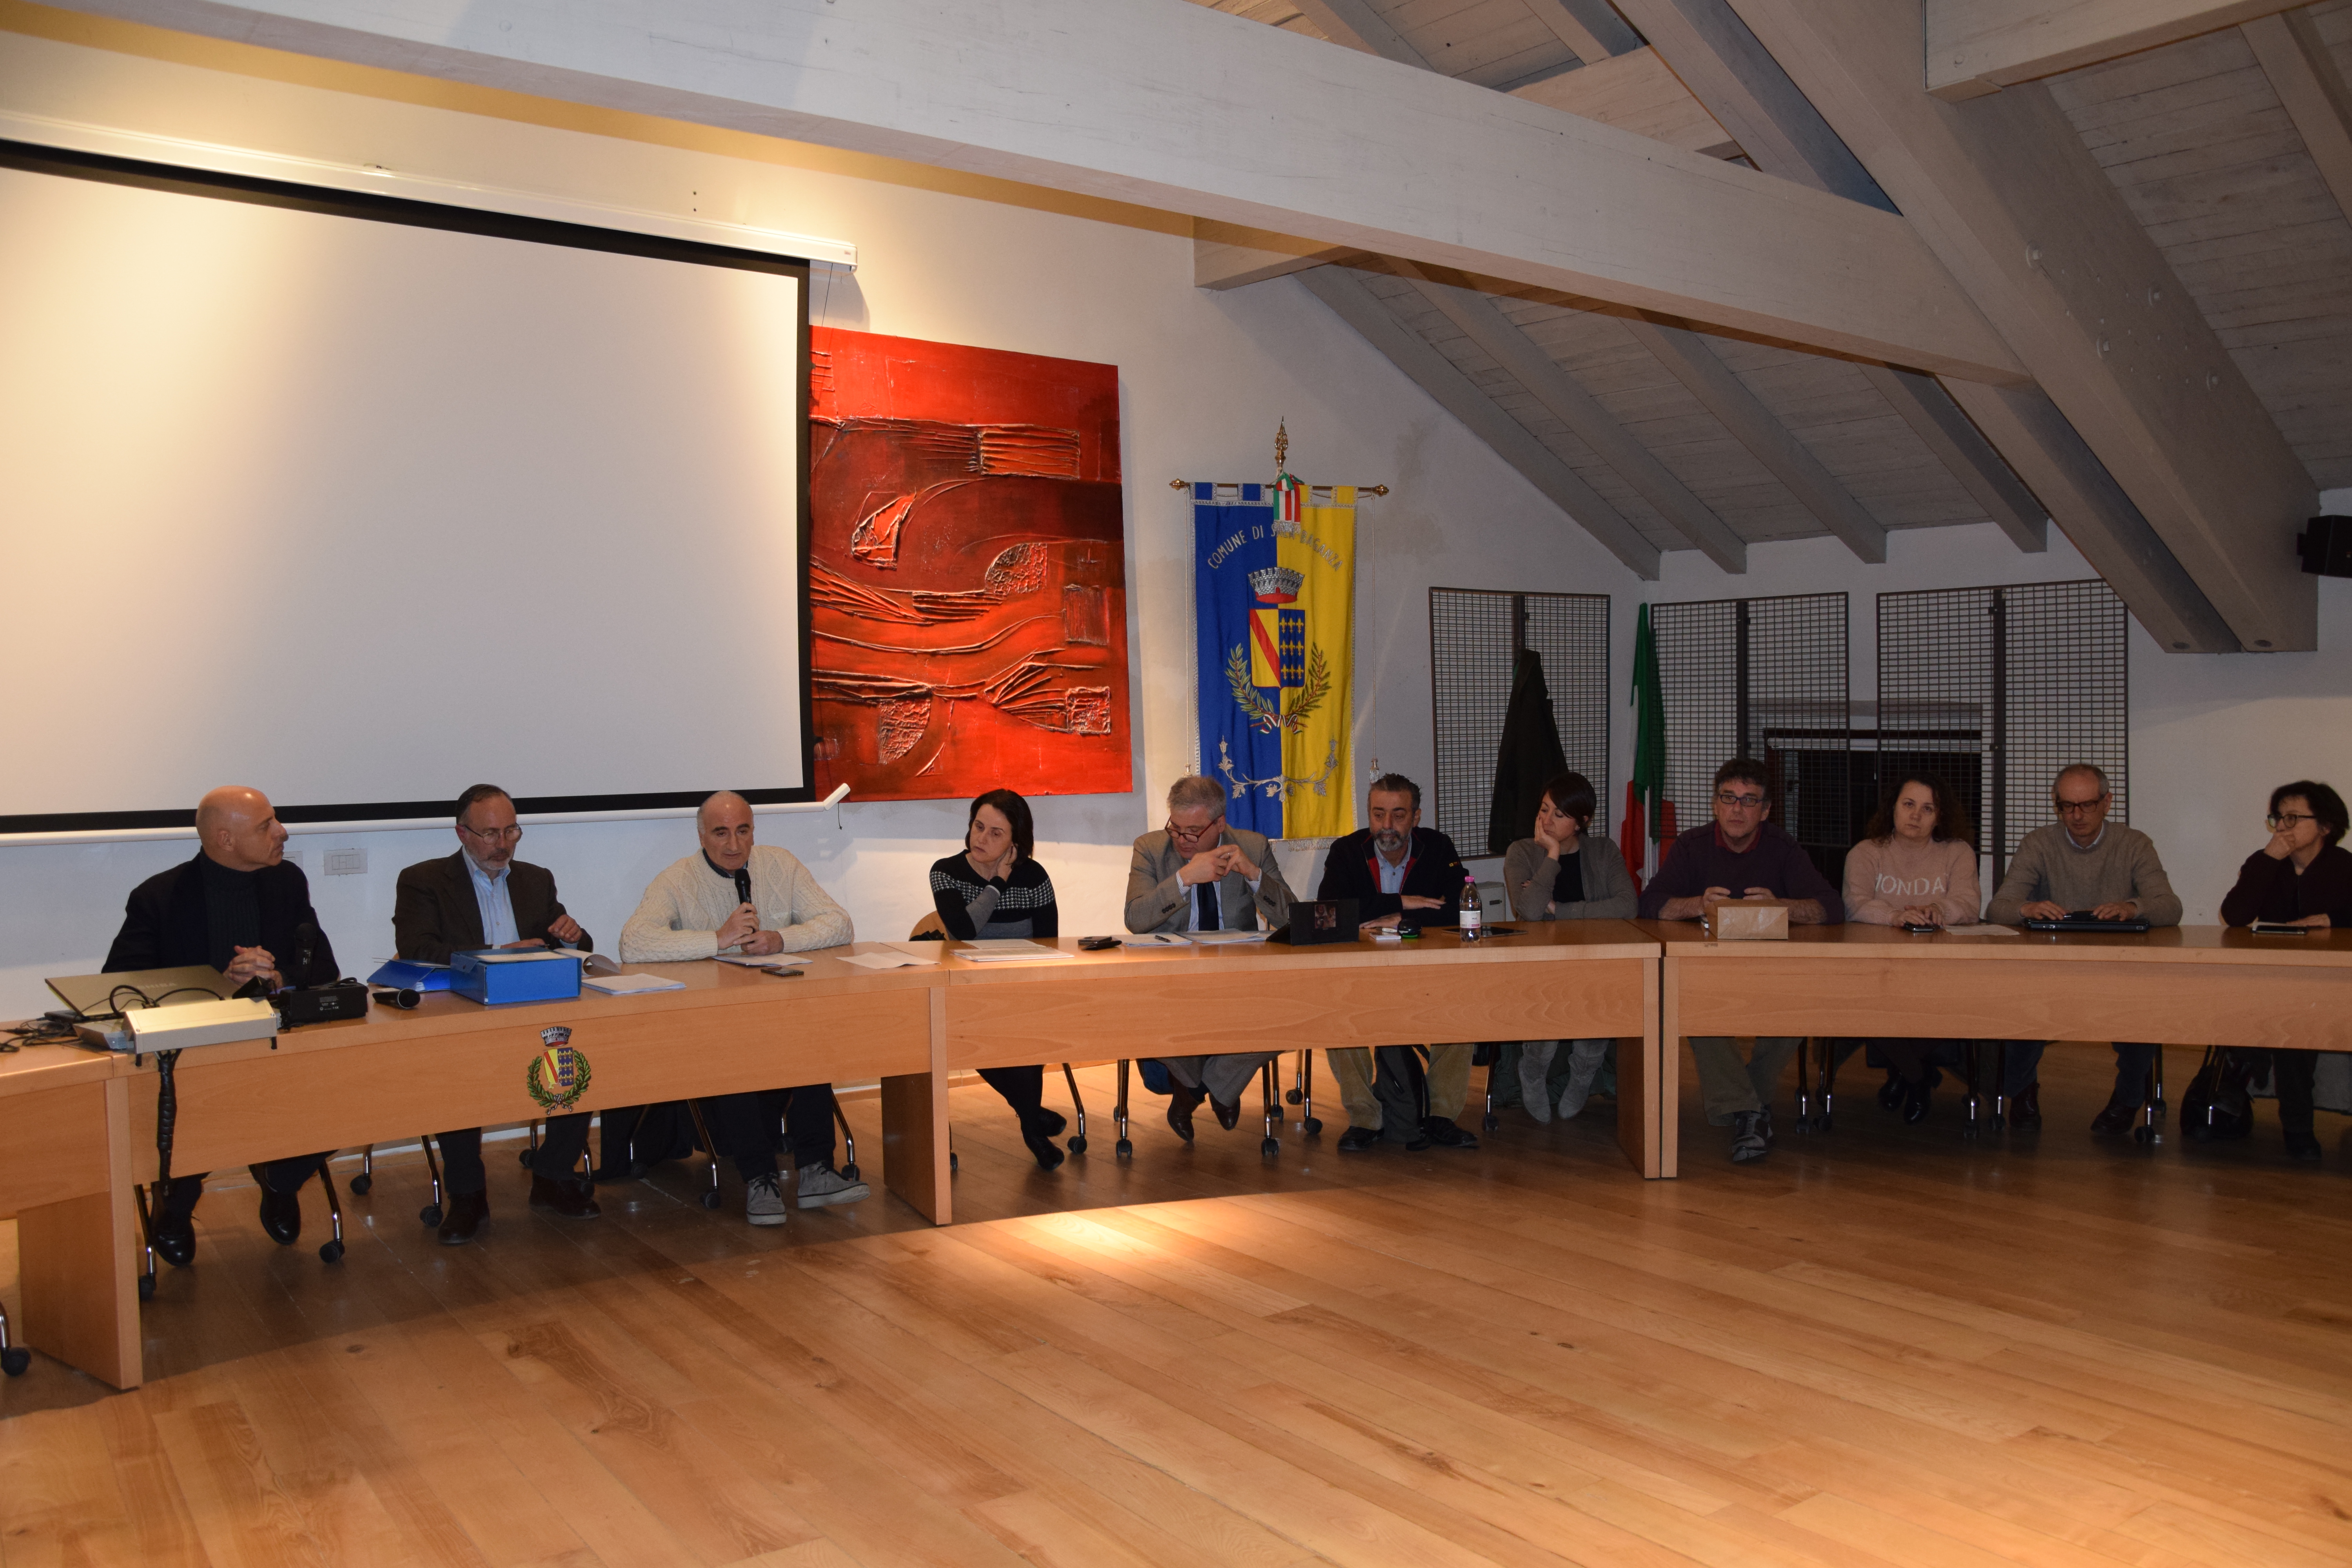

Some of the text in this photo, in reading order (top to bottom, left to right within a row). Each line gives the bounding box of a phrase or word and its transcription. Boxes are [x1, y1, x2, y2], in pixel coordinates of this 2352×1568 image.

[1208, 530, 1247, 569] COMUNE
[1252, 525, 1264, 539] DI
[1300, 530, 1343, 572] BAGANZA
